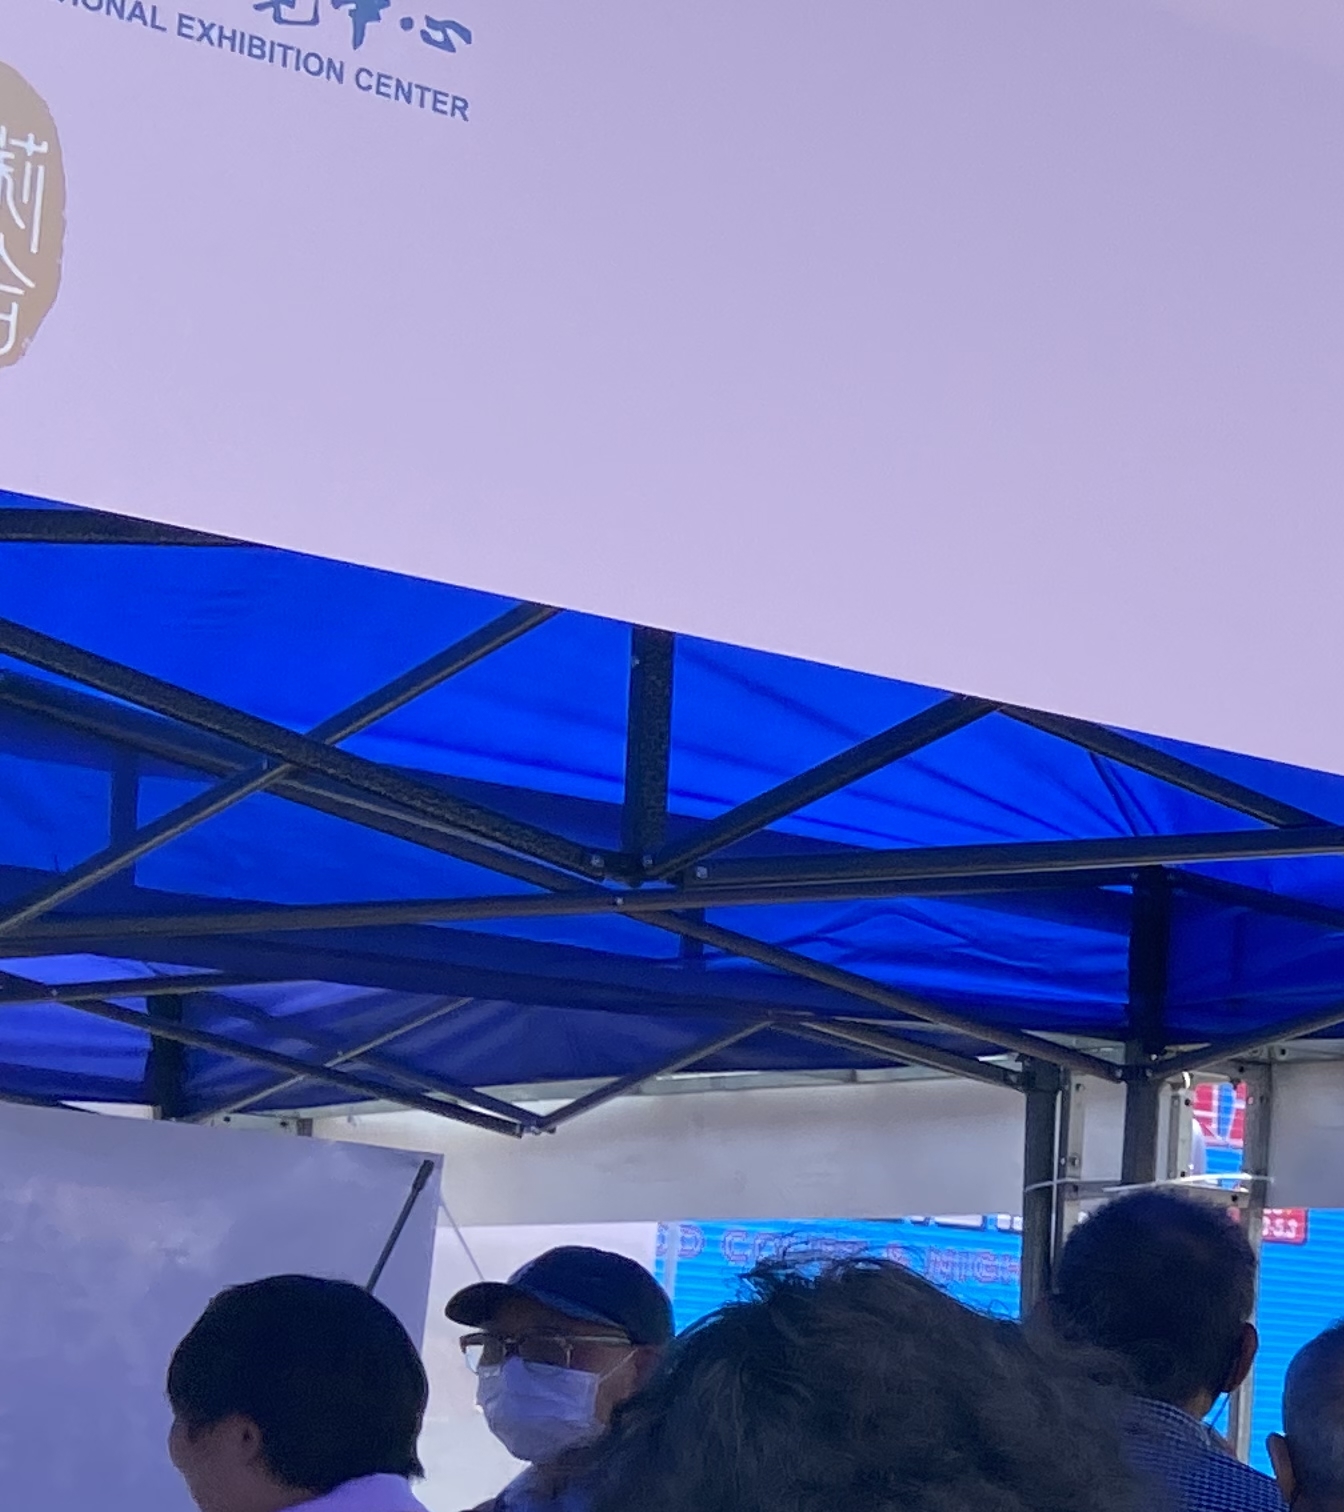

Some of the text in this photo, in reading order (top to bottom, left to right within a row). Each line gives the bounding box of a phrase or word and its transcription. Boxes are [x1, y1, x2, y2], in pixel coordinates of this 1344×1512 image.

[58, 0, 470, 122] ONAL EXHIBITION CENTER
